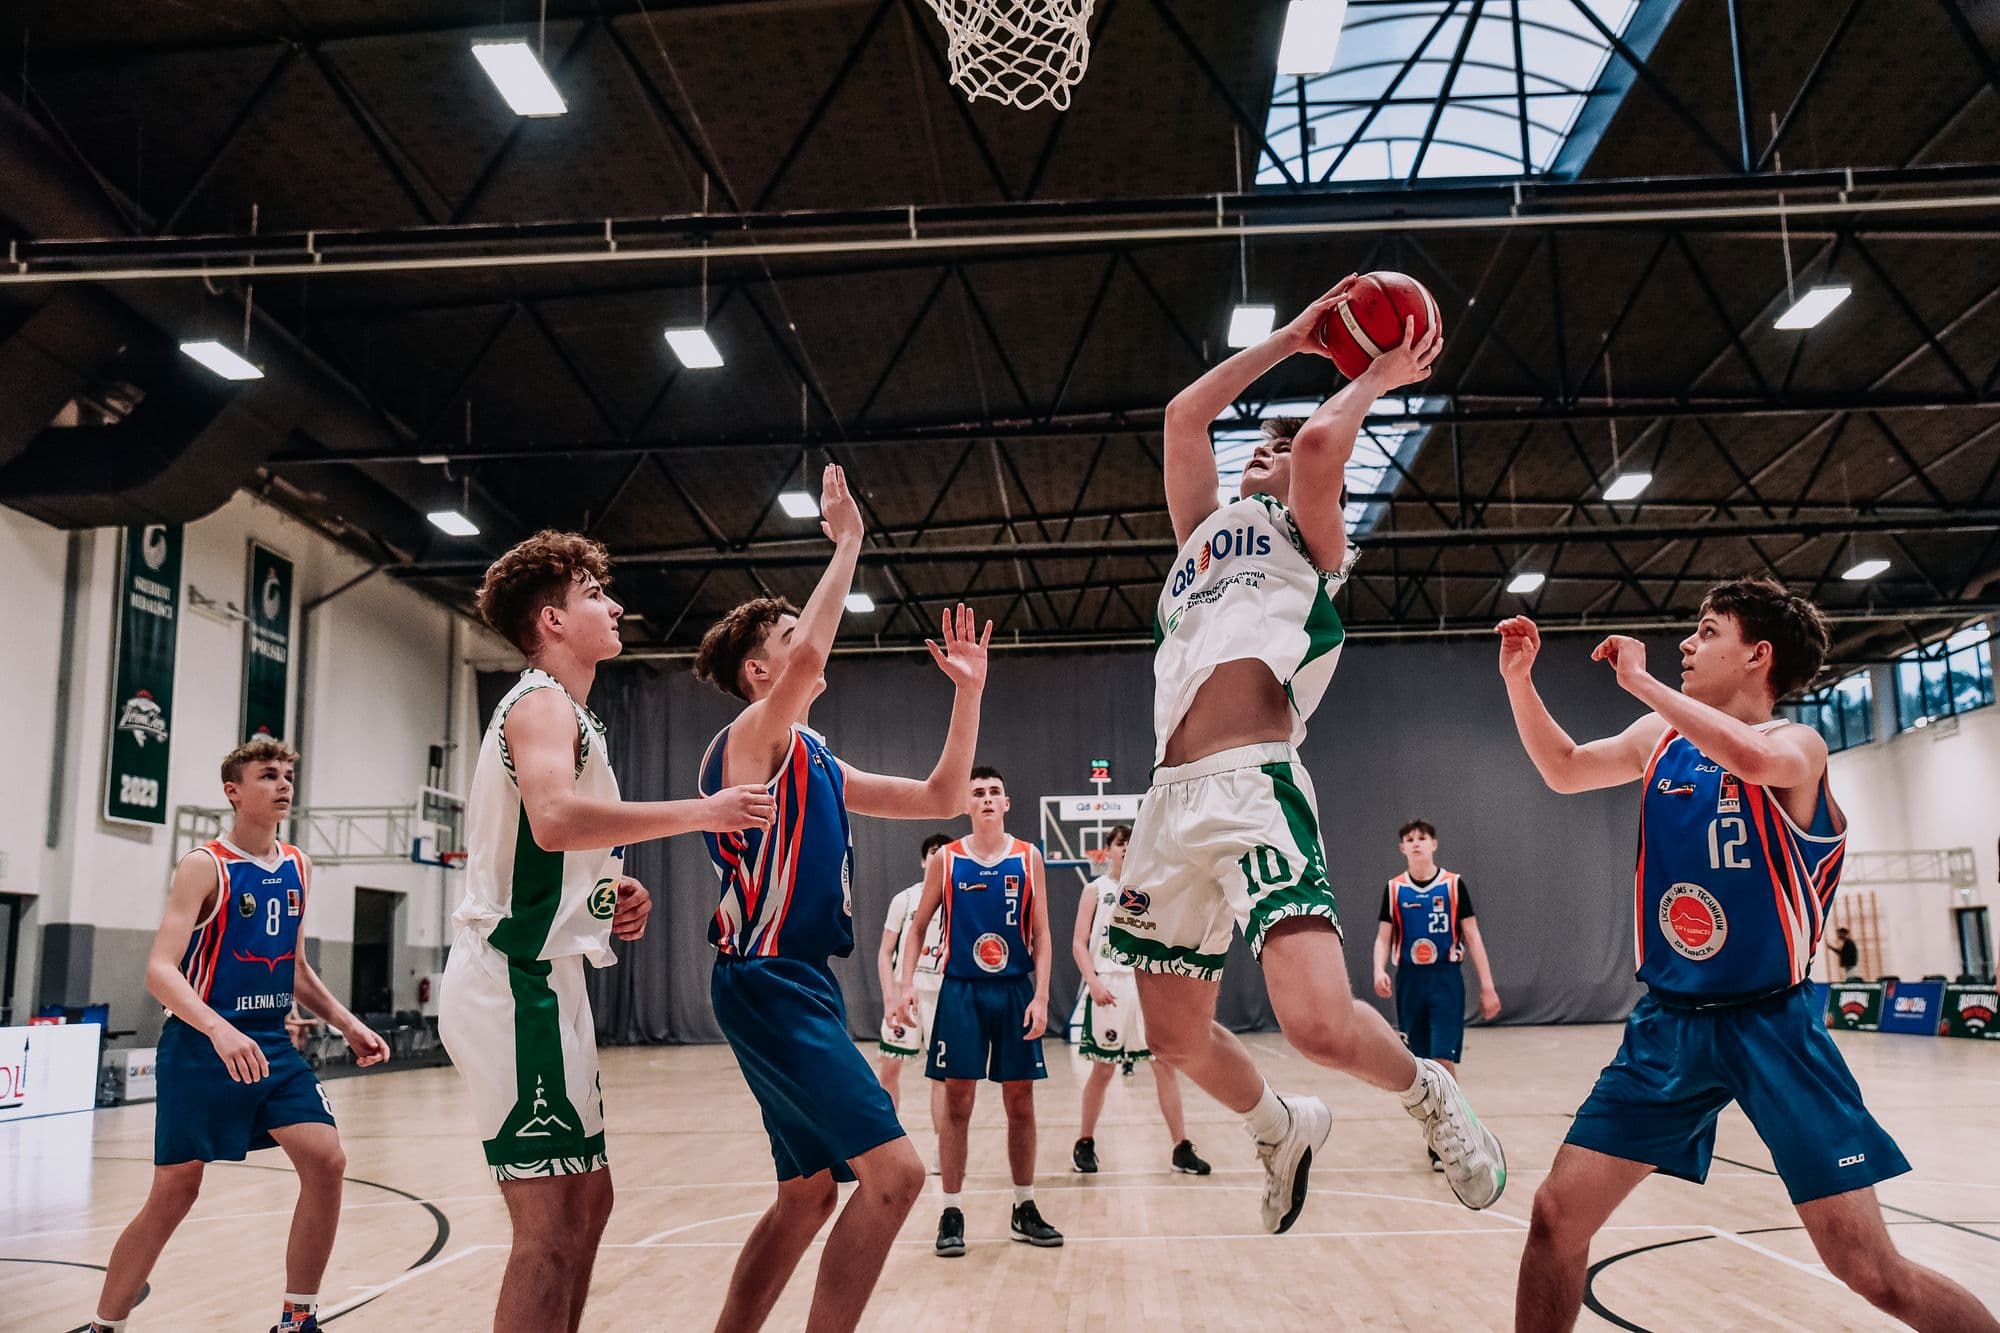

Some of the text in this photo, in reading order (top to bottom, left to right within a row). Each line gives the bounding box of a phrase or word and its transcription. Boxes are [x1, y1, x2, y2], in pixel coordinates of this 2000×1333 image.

[1172, 526, 1271, 597] Q8 Oils
[1092, 768, 1108, 778] 22
[121, 773, 159, 808] 2023
[1708, 817, 1751, 869] 12
[1237, 845, 1292, 894] 10
[266, 898, 281, 936] 8
[1005, 899, 1018, 926] 2
[1428, 912, 1449, 933] 23
[235, 994, 275, 1011] JELENIA
[936, 1040, 947, 1068] 2
